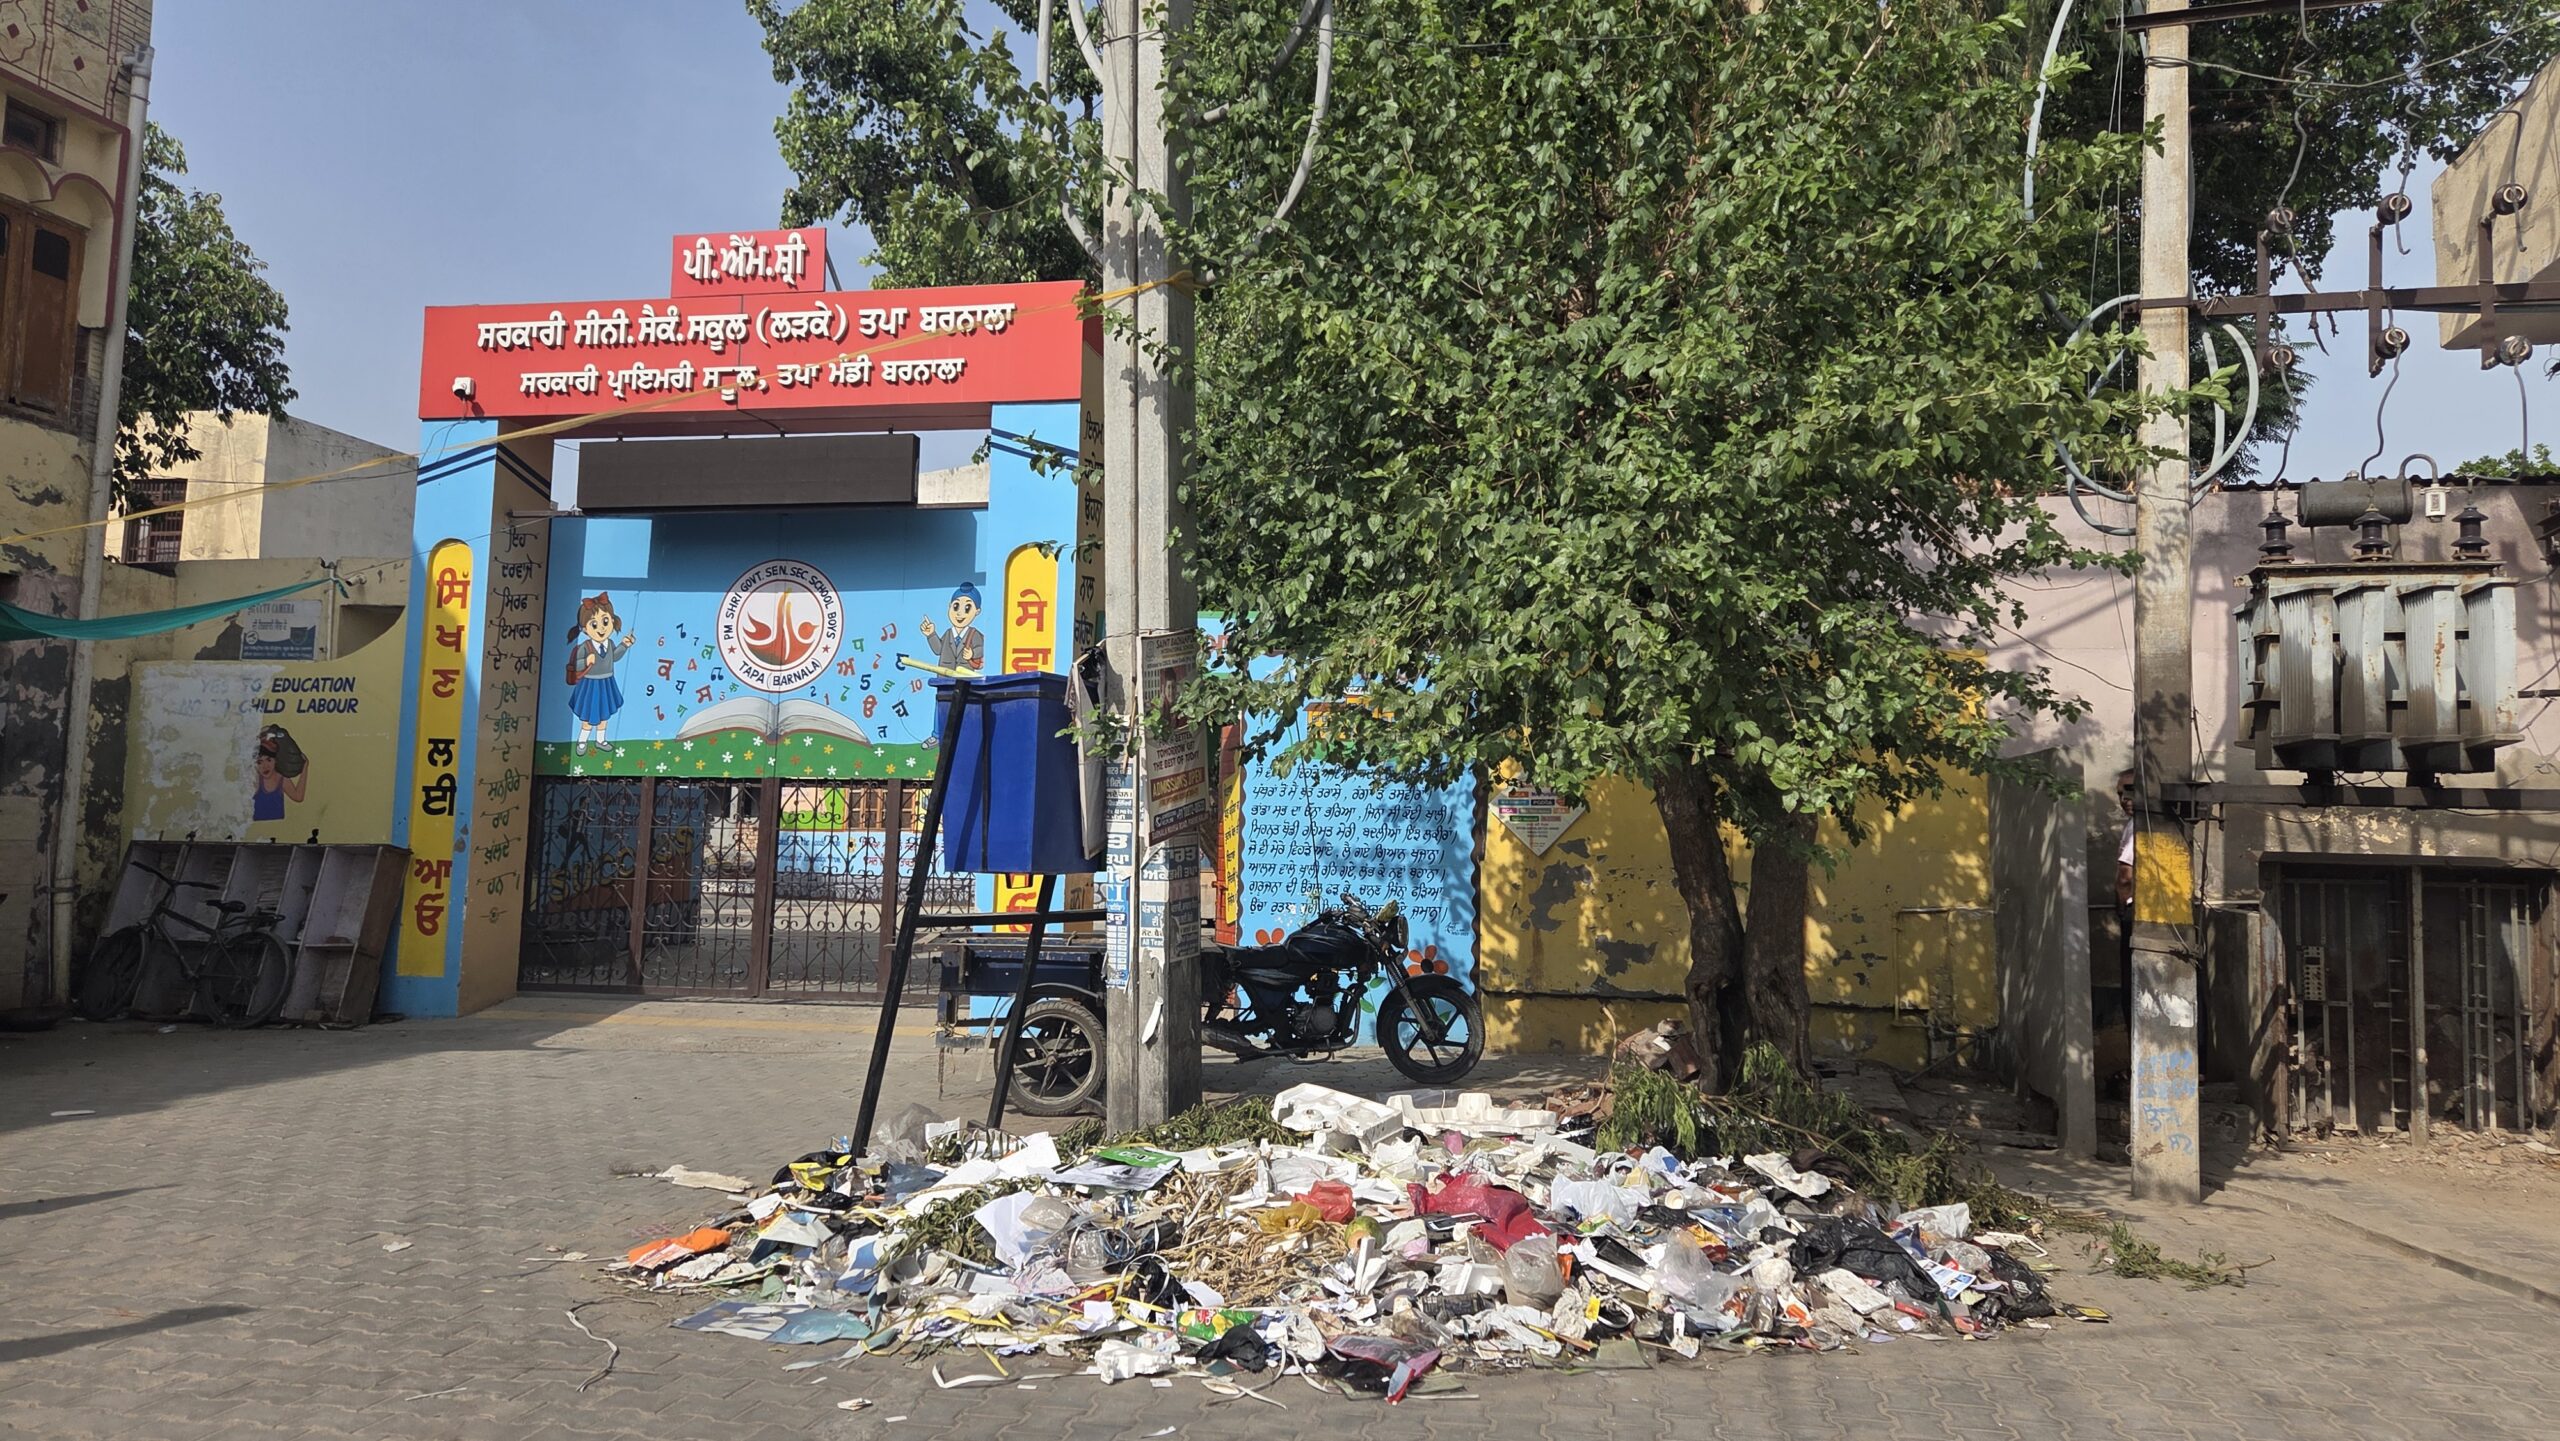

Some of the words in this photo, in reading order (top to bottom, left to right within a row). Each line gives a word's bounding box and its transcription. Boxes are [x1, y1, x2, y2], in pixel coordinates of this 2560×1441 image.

[477, 310, 566, 349] ਸਰਕਾਰੀ
[688, 313, 750, 352] ਸਕੂਲ
[755, 300, 848, 345] (ਲੜਕੇ)
[858, 307, 908, 336] ਤਪਾ
[919, 302, 1018, 335] ਬਰਨਾਲਾ
[520, 363, 600, 394] ਸਰਕਾਰੀ
[607, 360, 696, 400] ਪ੍ਰਾਇਮਰੀ
[777, 363, 821, 386] ਤਪਾ
[829, 354, 873, 385] ਮੰਡੀ
[881, 357, 967, 383] ਬਰਨਾਲਾ
[765, 565, 788, 577] SEN.
[790, 566, 809, 580] SEC.
[740, 571, 765, 592] GOVT.
[808, 575, 834, 610] SCHOOL
[725, 592, 743, 620] SHRI
[723, 624, 734, 641] PM
[827, 611, 838, 640] BOYS
[657, 636, 665, 647] 6
[693, 637, 699, 646] 7
[738, 660, 766, 684] TAPA
[766, 657, 823, 690] (BARNALA)
[860, 673, 872, 691] 5
[271, 676, 356, 693] EDUCATION
[646, 684, 655, 697] 9
[810, 685, 817, 698] 2
[909, 678, 922, 693] 10
[239, 697, 286, 714] CHILD
[296, 697, 359, 714] LABOUR
[823, 693, 830, 706] 1
